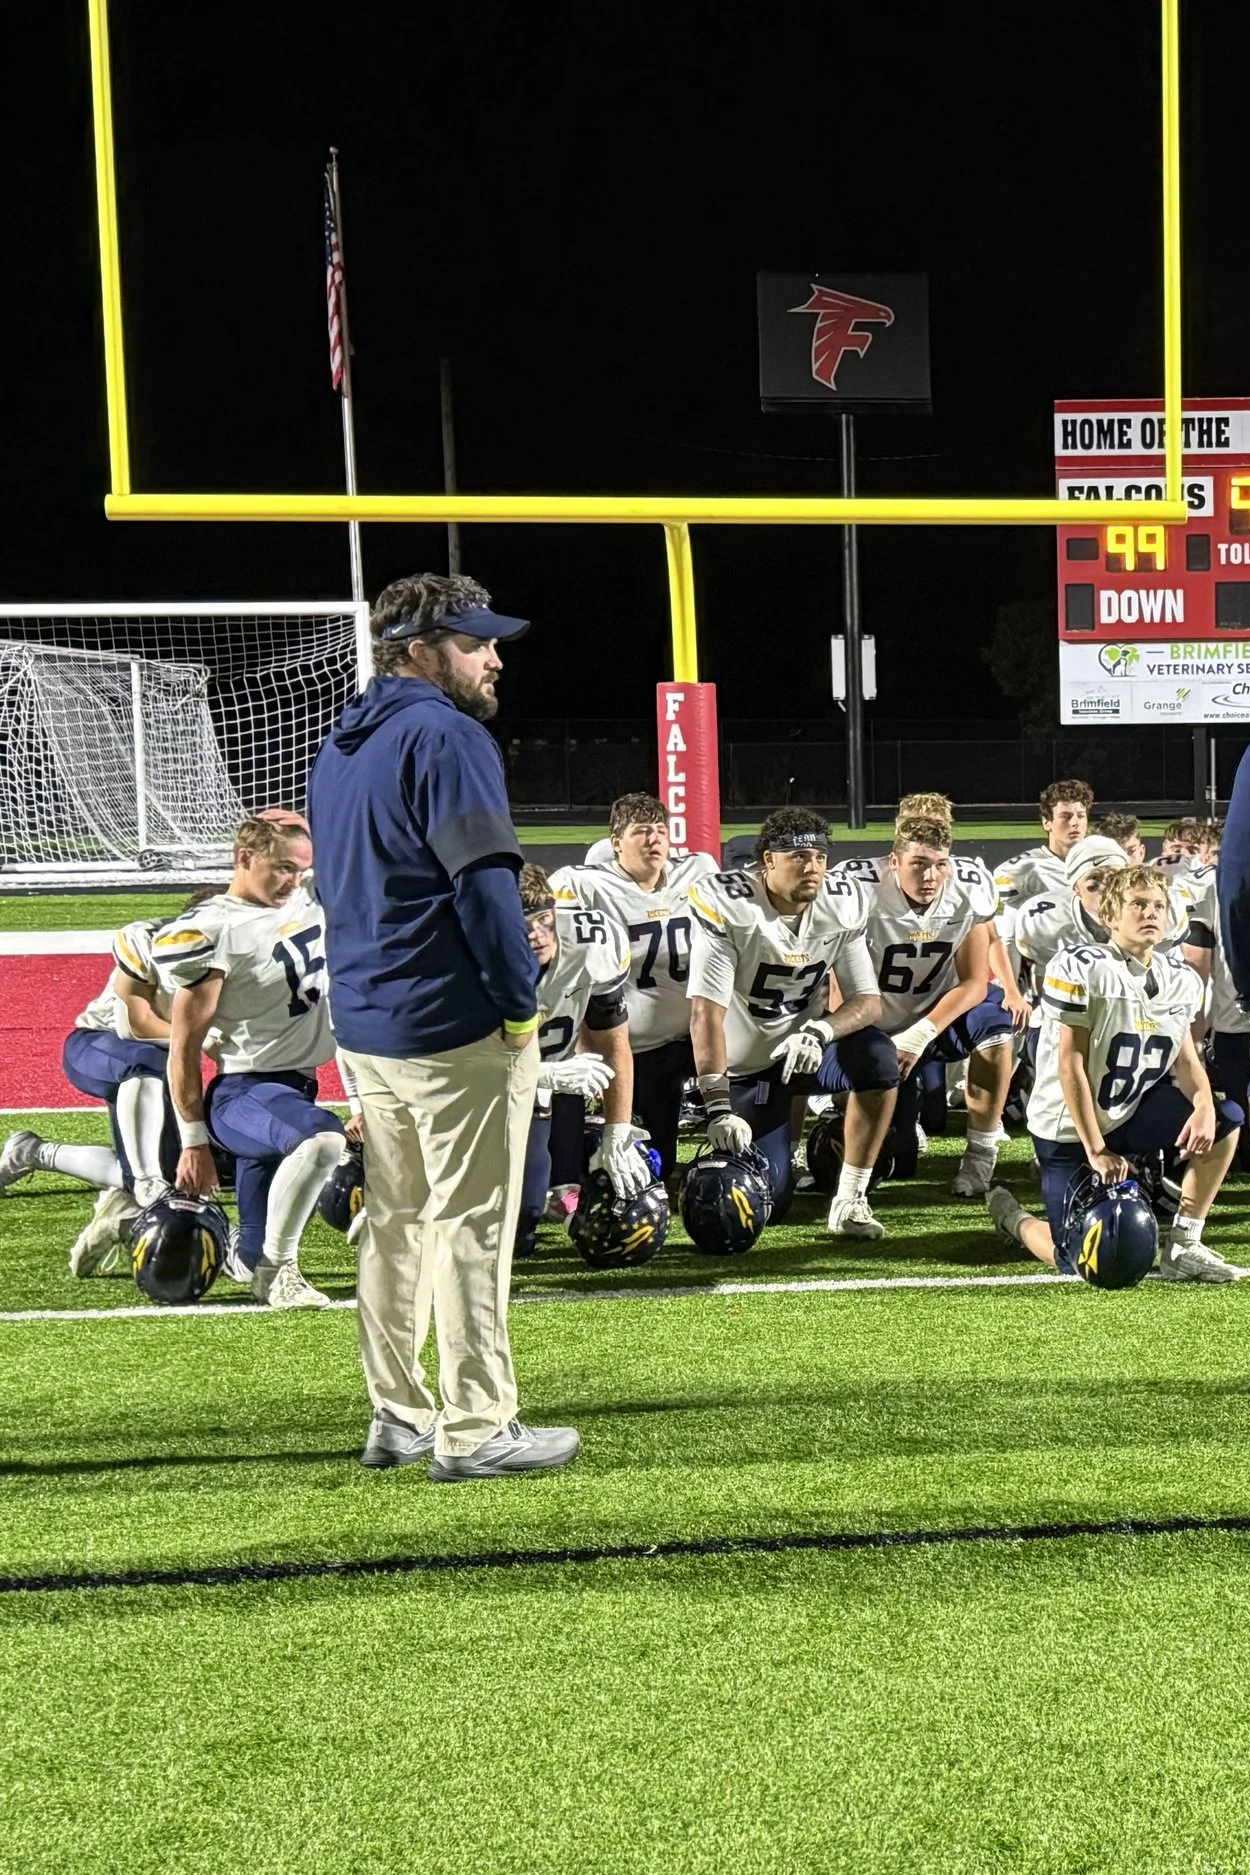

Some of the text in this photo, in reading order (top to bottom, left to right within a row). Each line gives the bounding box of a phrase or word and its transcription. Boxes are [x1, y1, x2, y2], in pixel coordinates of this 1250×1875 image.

[1062, 418, 1132, 450] HOME
[1181, 416, 1231, 449] THE
[1106, 525, 1166, 571] 99
[1100, 589, 1184, 624] DOWN
[1146, 663, 1234, 676] VETERINARY
[1071, 699, 1121, 709] Brimfield
[1143, 701, 1182, 711] Grange
[1028, 900, 1057, 918] 4
[573, 910, 608, 945] 52
[628, 916, 692, 990] 70
[877, 940, 954, 995] 67
[271, 924, 326, 1018] 15
[747, 960, 828, 1019] 53
[1097, 1031, 1174, 1111] 82
